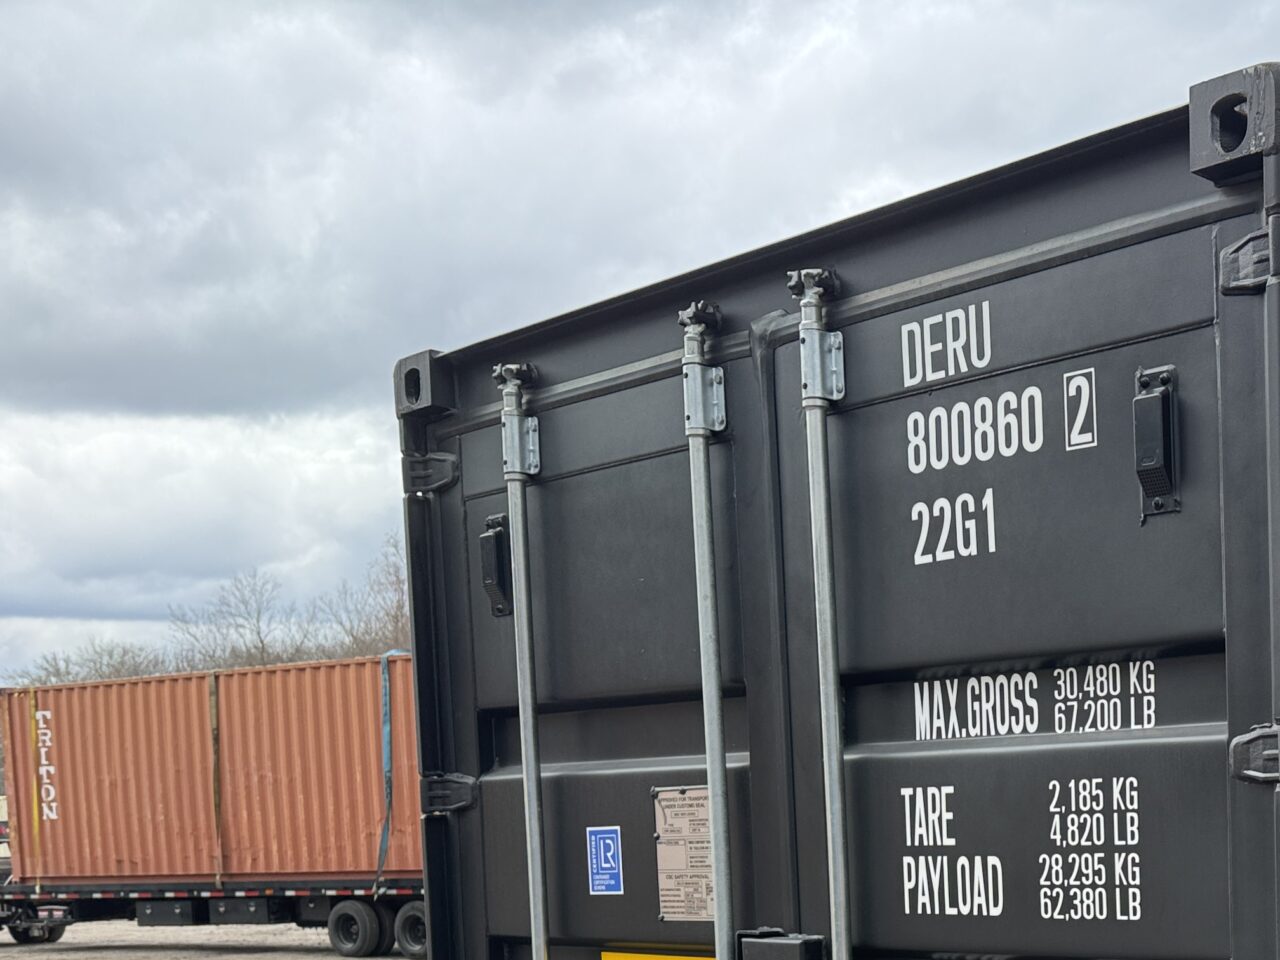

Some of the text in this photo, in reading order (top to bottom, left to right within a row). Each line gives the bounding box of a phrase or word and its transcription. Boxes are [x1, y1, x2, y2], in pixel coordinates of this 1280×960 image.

[901, 300, 992, 389] DERU
[906, 371, 1094, 474] 800860 2
[911, 487, 997, 566] 22G1
[913, 671, 1040, 741] MAX.GROSS
[1052, 659, 1156, 701] 30,480 KG
[1053, 695, 1156, 735] 67,200 LB
[35, 709, 59, 821] TRITON
[1048, 776, 1139, 815] 2,185 KG
[900, 785, 957, 847] TARE
[1049, 812, 1140, 849] 4,820 LB
[902, 855, 1004, 916] PAYLOAD
[1038, 852, 1141, 888] 28,295 KG
[1039, 887, 1142, 922] 62,380 LB
